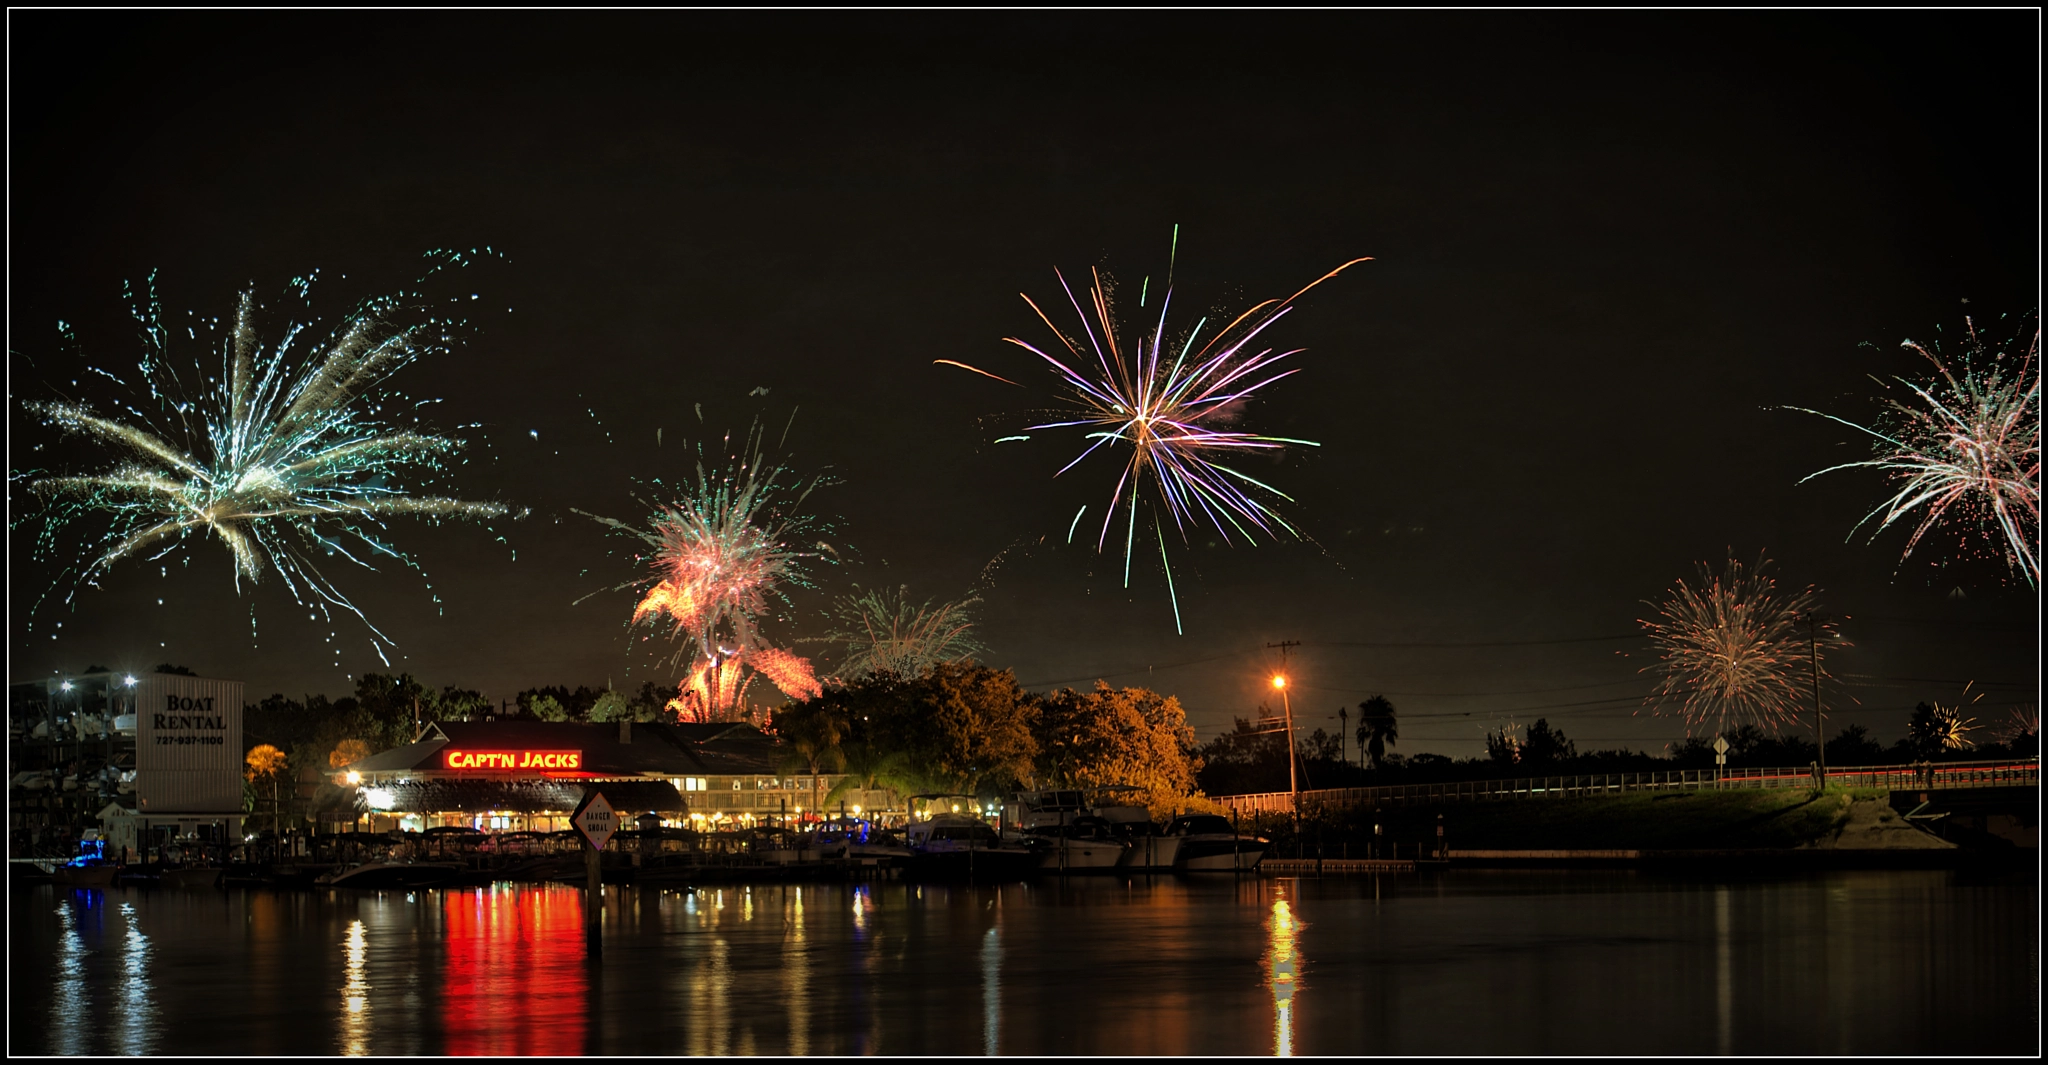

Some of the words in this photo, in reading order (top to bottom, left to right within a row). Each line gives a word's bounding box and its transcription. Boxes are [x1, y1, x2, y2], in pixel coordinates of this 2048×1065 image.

[166, 695, 215, 711] BOAT
[153, 713, 227, 730] RENTAL
[156, 736, 224, 745] 727-937-1100
[448, 752, 515, 768] CAPT'N
[520, 752, 579, 768] JACKS
[586, 812, 611, 821] DANGER
[588, 824, 608, 832] SHOAL
